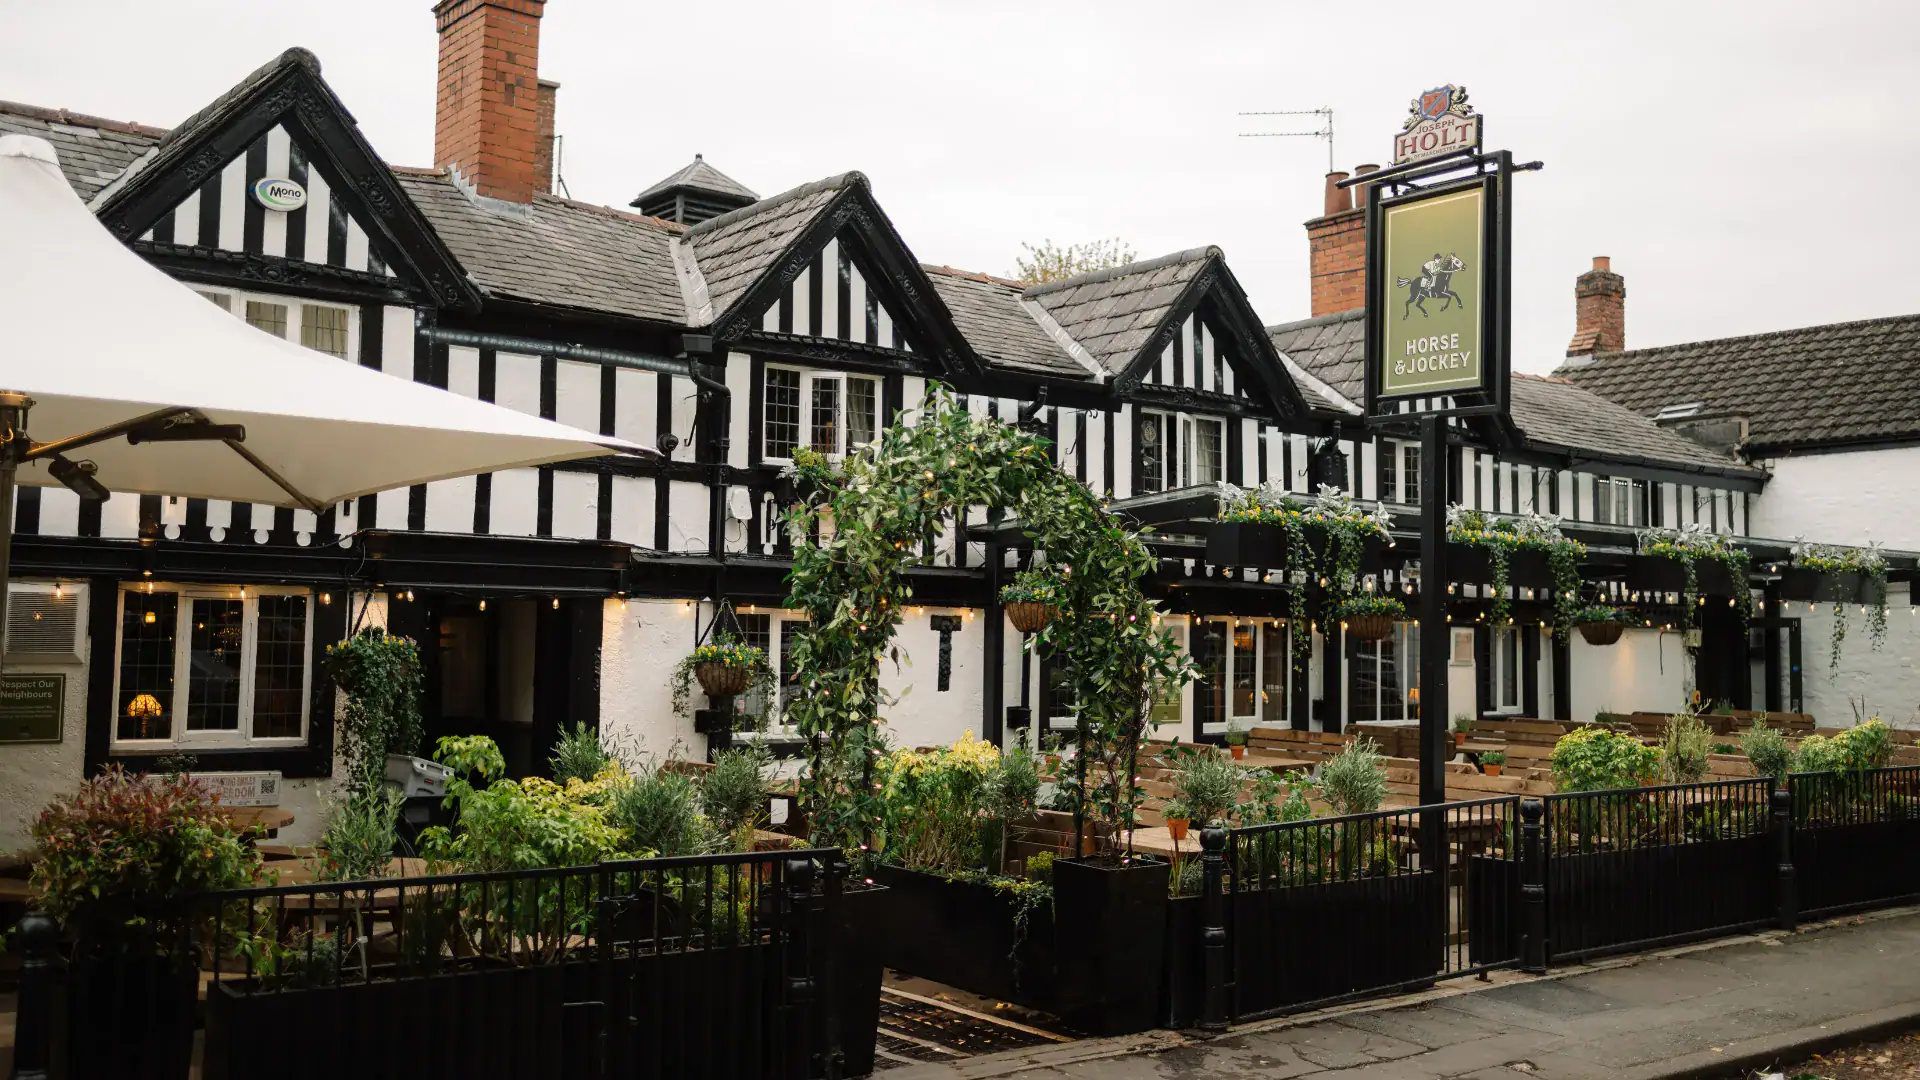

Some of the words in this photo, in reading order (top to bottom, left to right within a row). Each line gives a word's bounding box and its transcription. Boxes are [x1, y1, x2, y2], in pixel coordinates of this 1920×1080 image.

[1416, 119, 1455, 134] JOSEPH
[1399, 122, 1473, 156] HOLT
[269, 186, 301, 198] Mono
[1405, 333, 1459, 355] HORSE
[1394, 351, 1471, 375] &JOCKEY
[38, 680, 56, 688] Our
[0, 691, 53, 700] Neighbours
[211, 785, 256, 798] REEDOM
